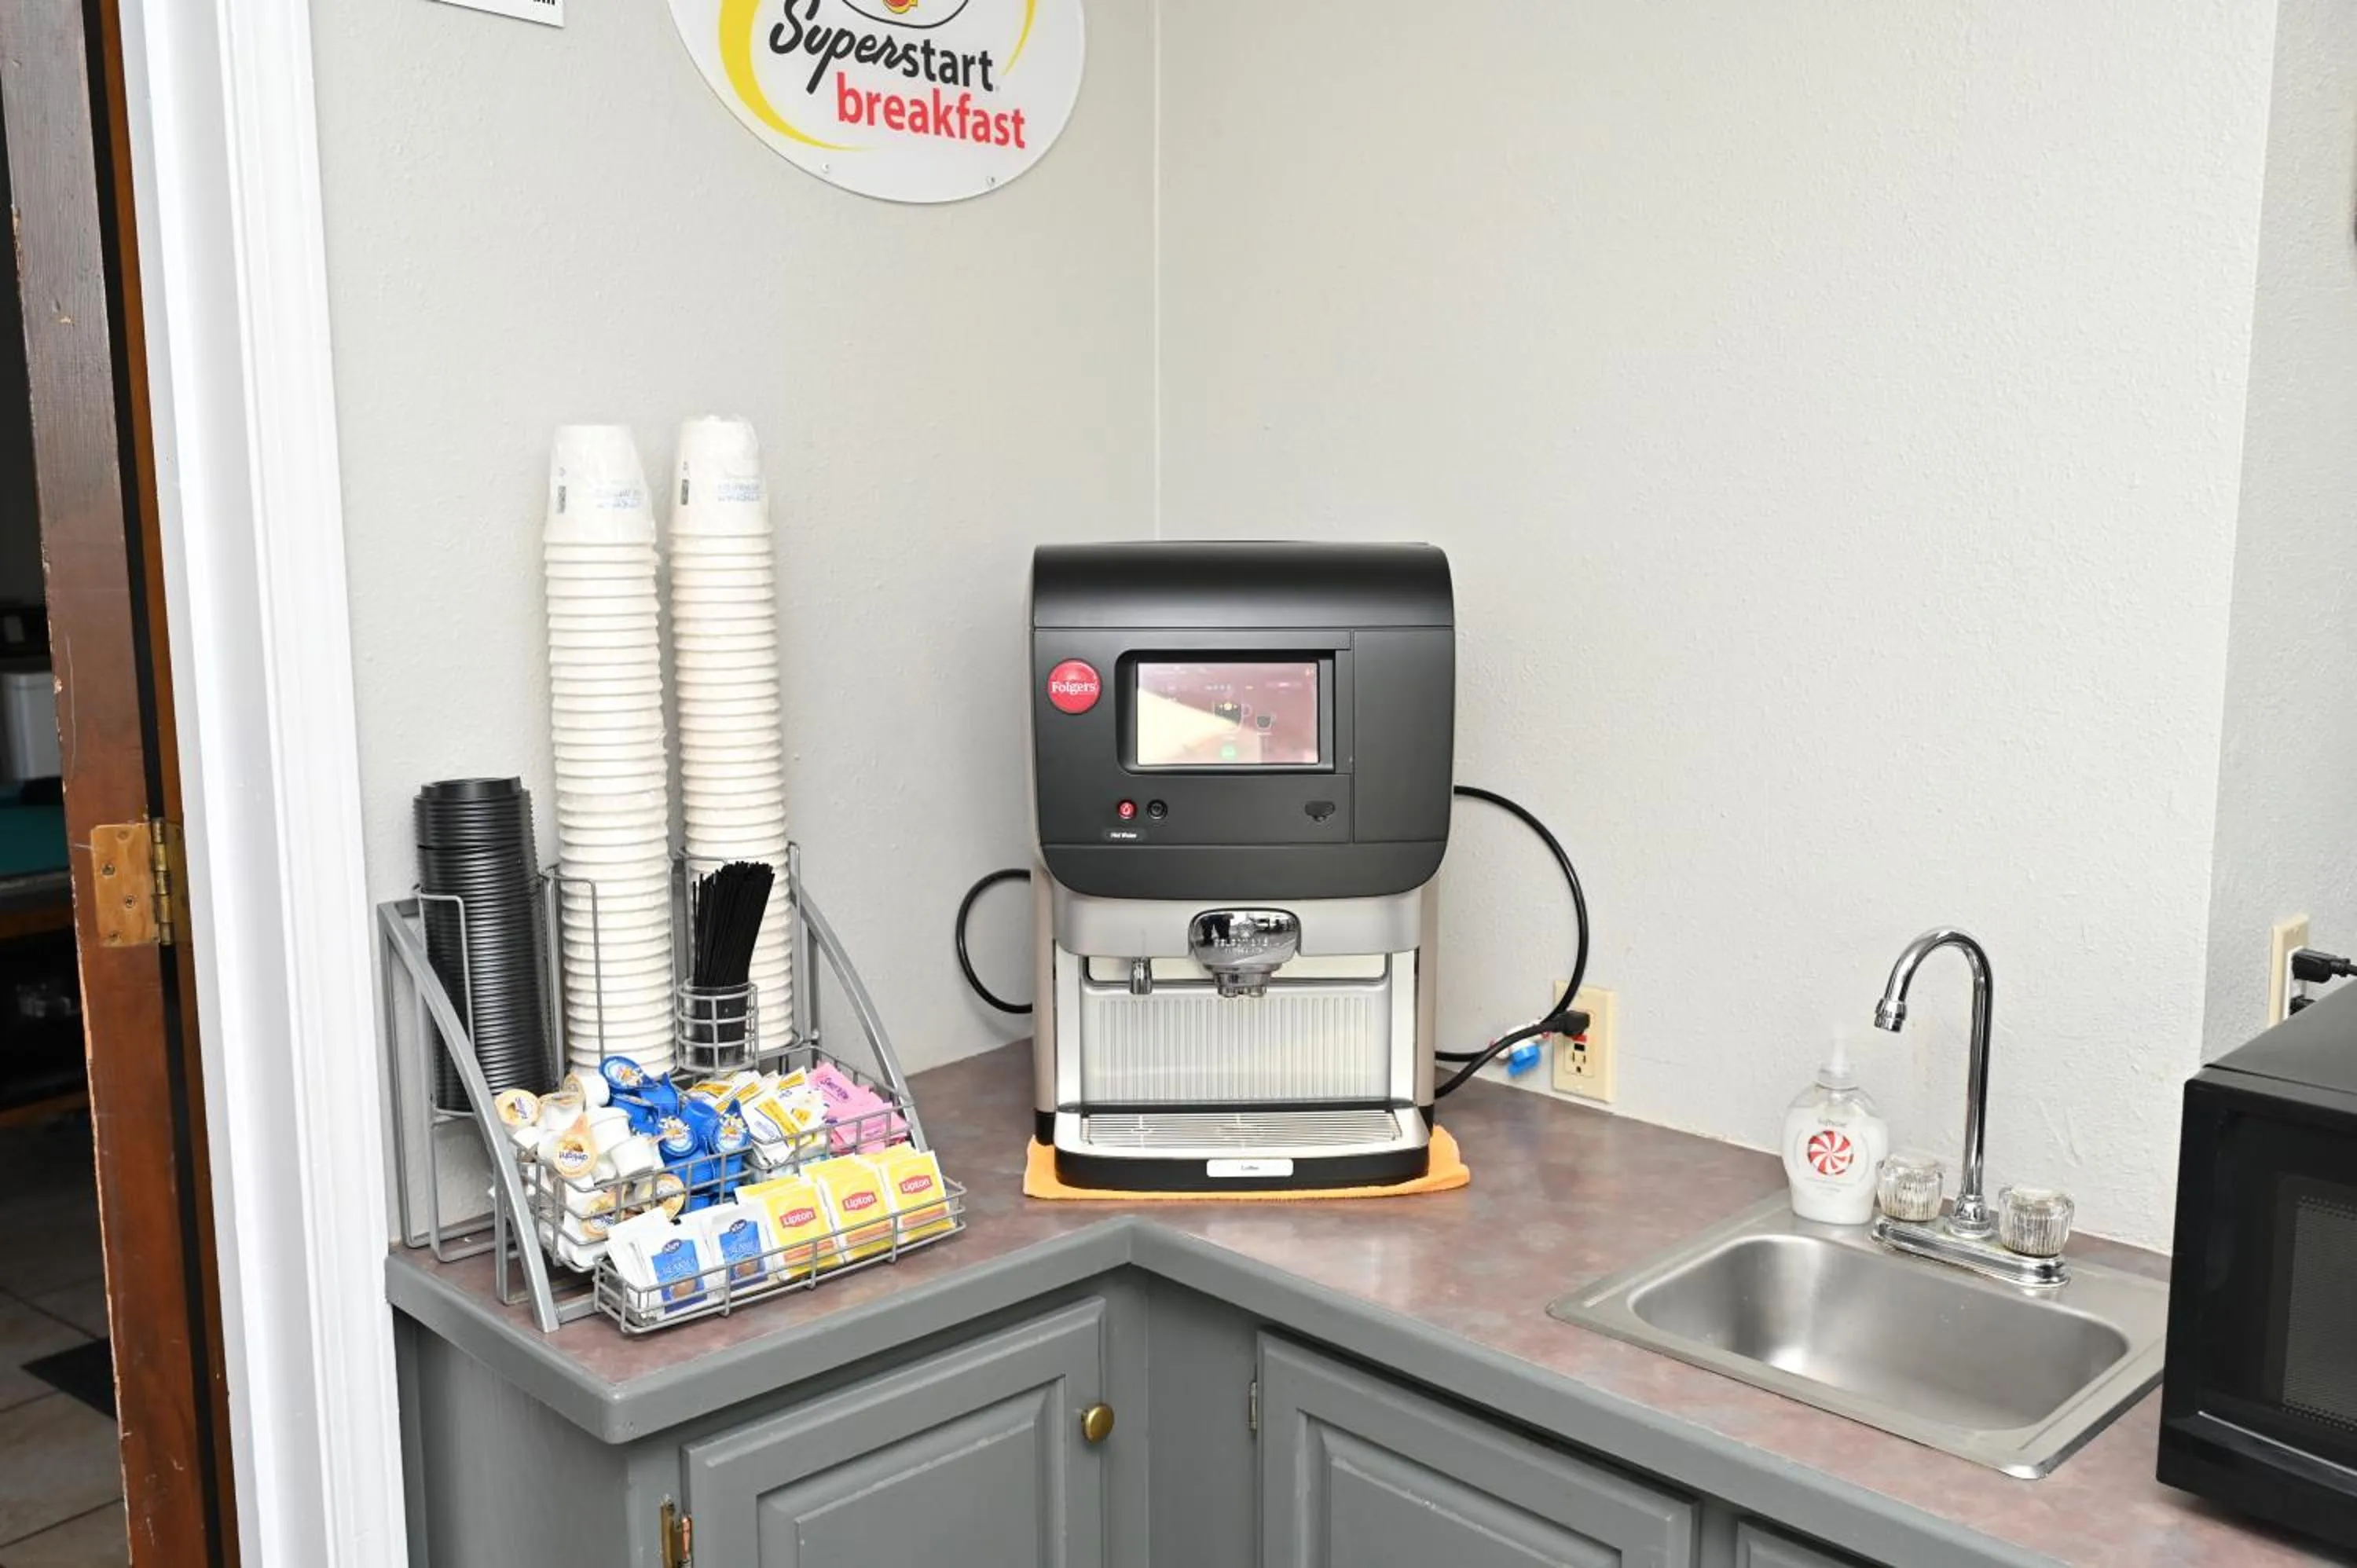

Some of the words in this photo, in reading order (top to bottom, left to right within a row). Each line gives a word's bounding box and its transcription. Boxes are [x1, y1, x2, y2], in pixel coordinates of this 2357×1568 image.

[769, 0, 994, 94] Superstart
[837, 72, 1026, 148] breakfast
[1051, 681, 1096, 696] Folgers
[901, 1178, 931, 1193] Lipton
[844, 1192, 876, 1209] Lipton
[783, 1210, 815, 1225] Lipton
